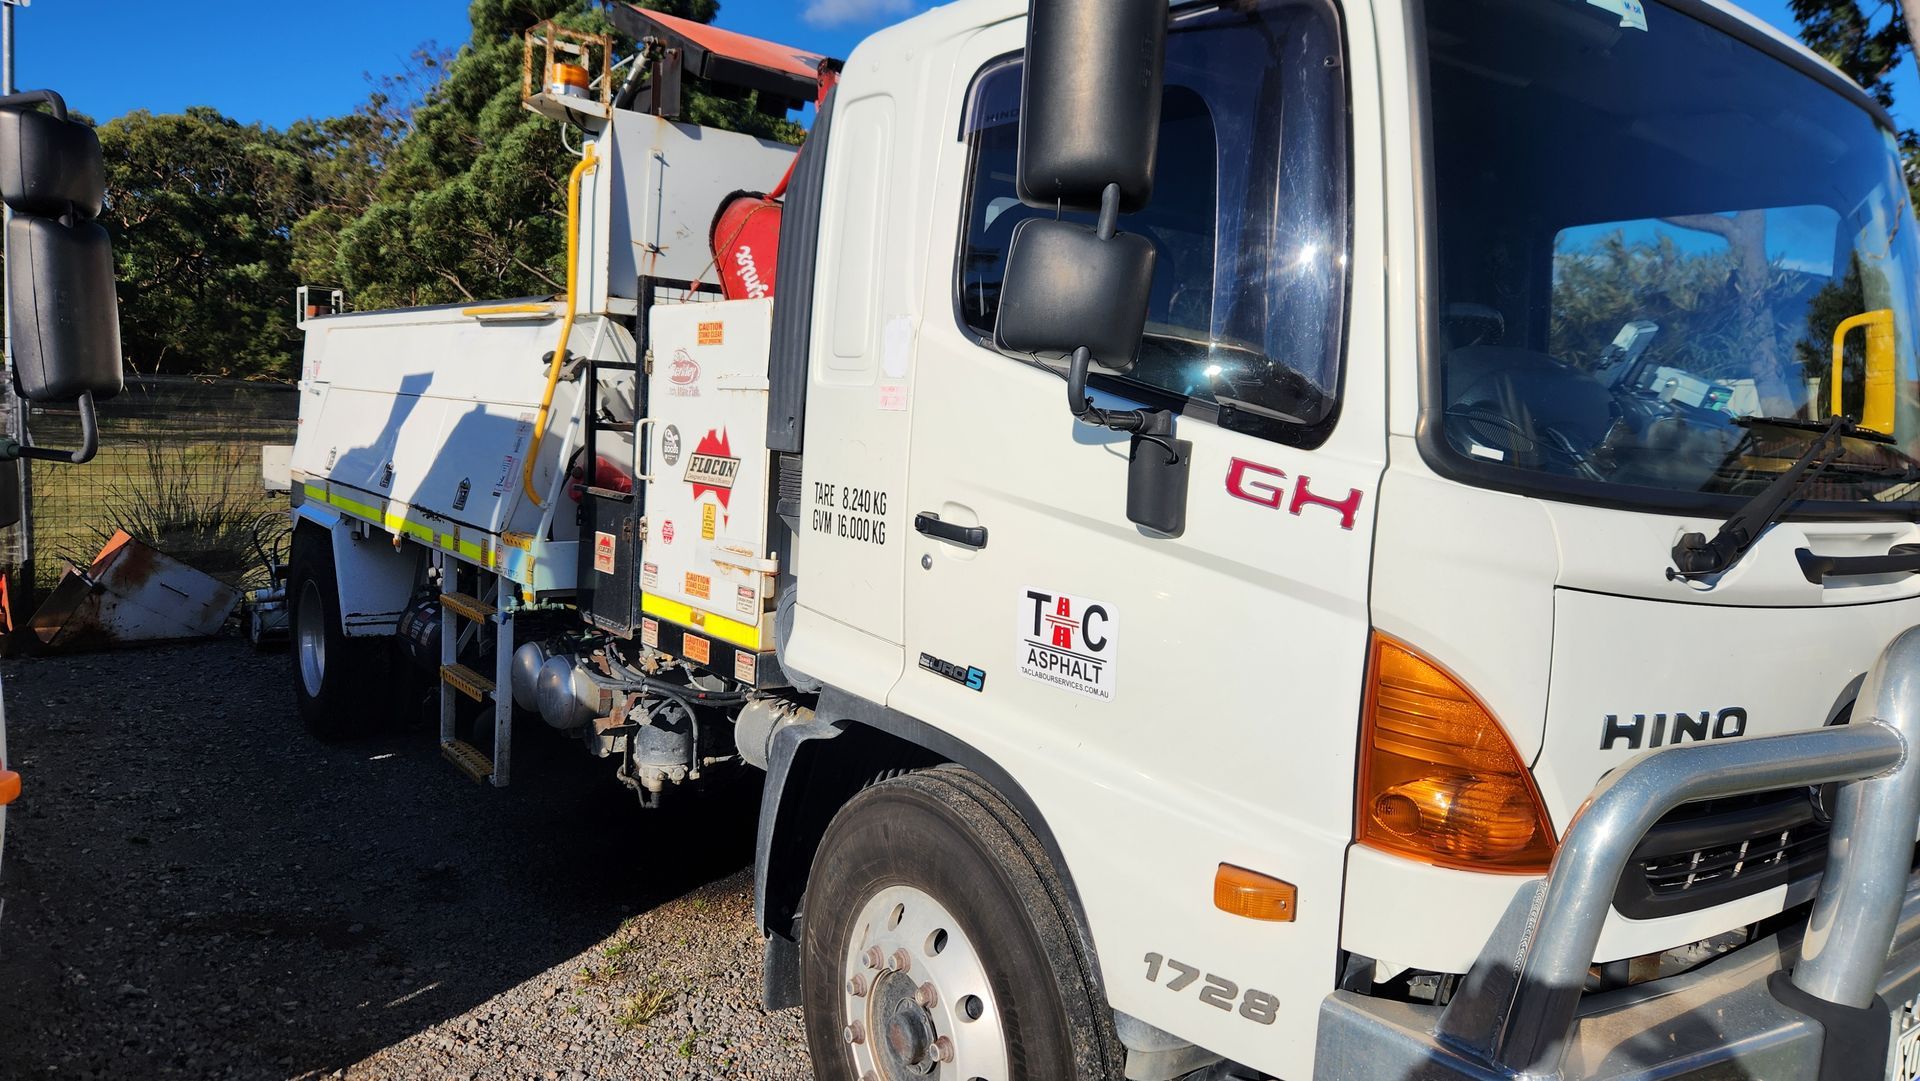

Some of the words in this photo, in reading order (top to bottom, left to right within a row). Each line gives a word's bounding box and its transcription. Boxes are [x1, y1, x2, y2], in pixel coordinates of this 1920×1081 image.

[698, 322, 723, 331] CAUTION
[690, 456, 737, 478] FLOCON
[814, 481, 835, 507] TARE
[842, 487, 871, 513] 8.240
[873, 490, 887, 516] KG
[1225, 456, 1364, 531] GH
[812, 509, 832, 535] GVM
[837, 514, 870, 542] 16.000
[871, 519, 886, 545] KG
[686, 571, 710, 584] CAUTION
[1021, 666, 1109, 699] TACLABOURSERVICES.COM.AU
[1027, 647, 1103, 684] ASPHALT
[1600, 706, 1748, 750] HINO
[1143, 951, 1281, 1025] 1728
